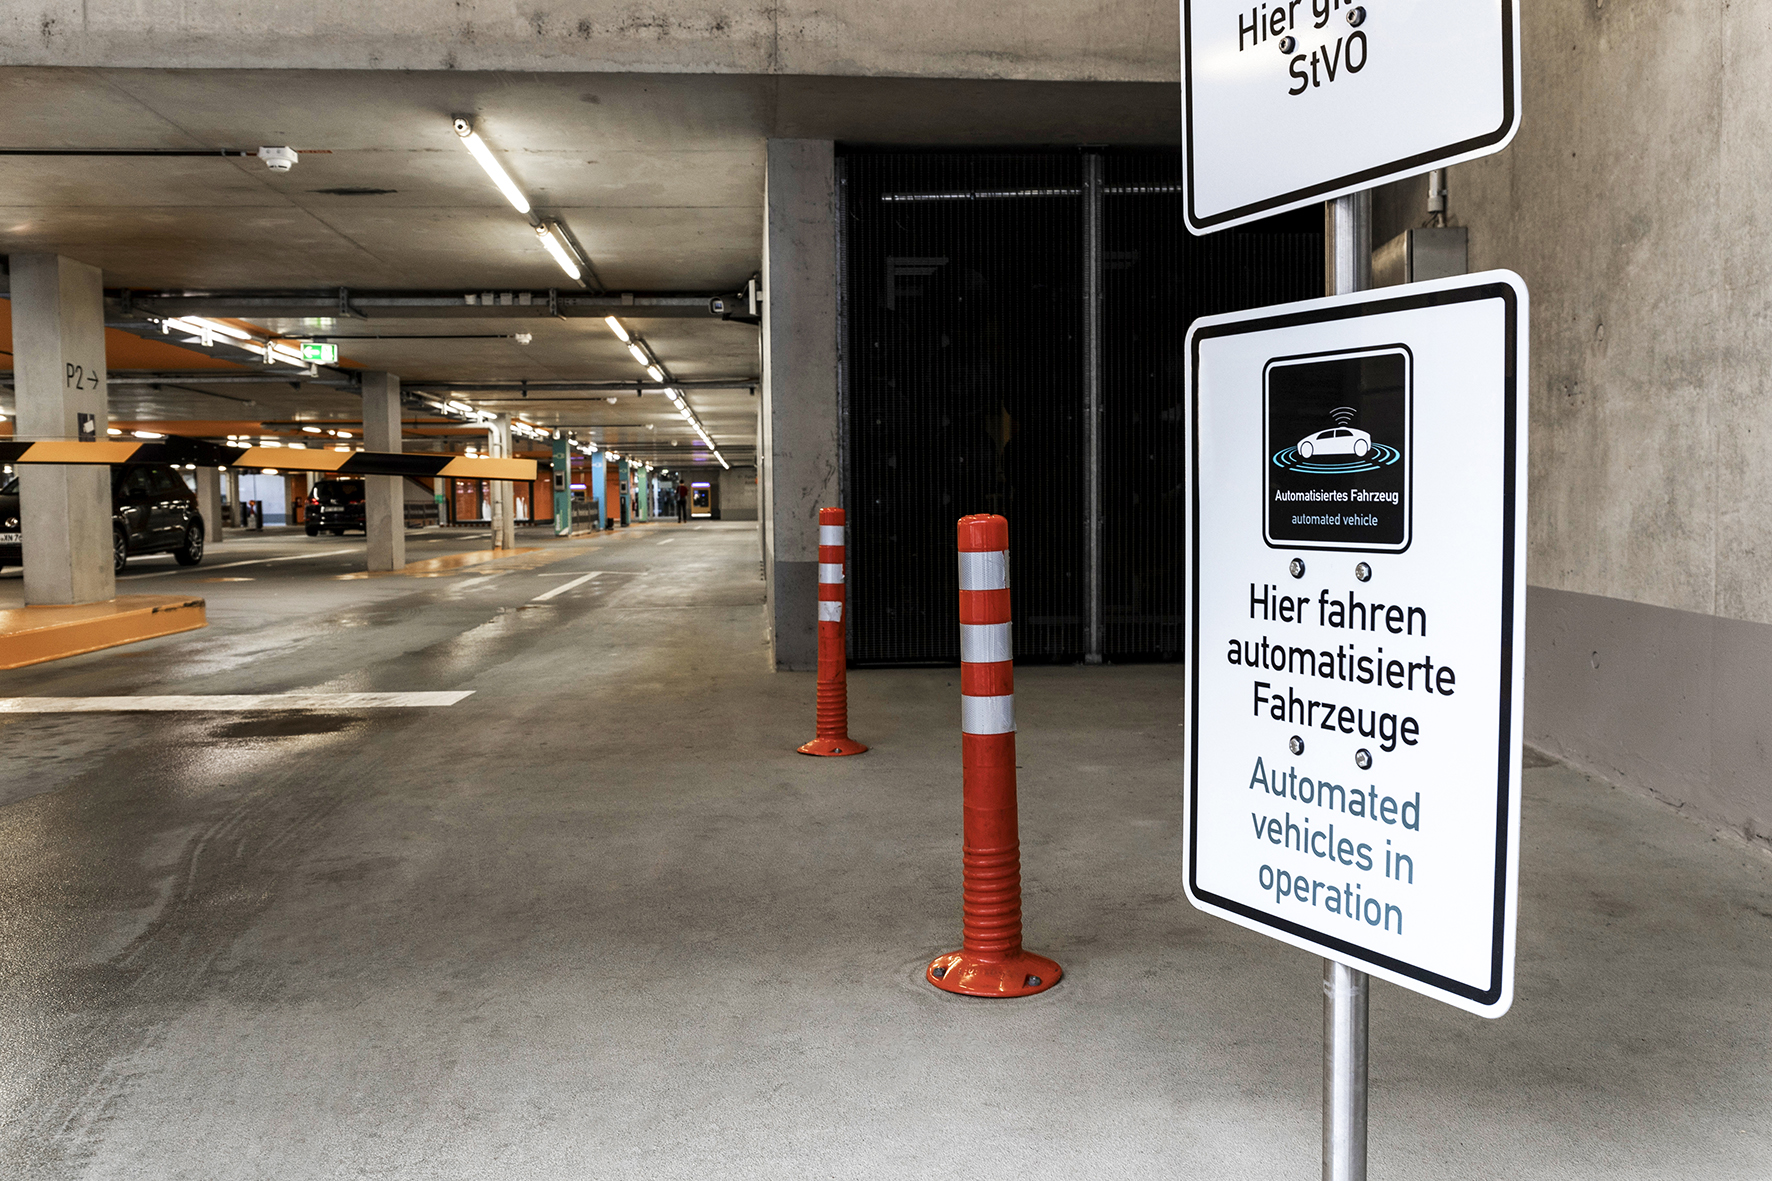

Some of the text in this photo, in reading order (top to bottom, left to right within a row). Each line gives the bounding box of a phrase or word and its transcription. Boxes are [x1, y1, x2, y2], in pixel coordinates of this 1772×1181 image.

[1239, 1, 1302, 52] Hier
[1288, 30, 1368, 96] StVO
[66, 362, 84, 390] P2
[1275, 489, 1399, 505] Automatisiertes Fahrzeug
[1291, 513, 1378, 526] automated vehicle
[1250, 583, 1427, 637] Hier fahren
[1227, 635, 1456, 696] automatisierte
[1253, 680, 1420, 752] Fahrzeuge
[1249, 756, 1420, 832] Automated
[1251, 811, 1414, 885] vehicles in
[1258, 863, 1403, 936] operation
